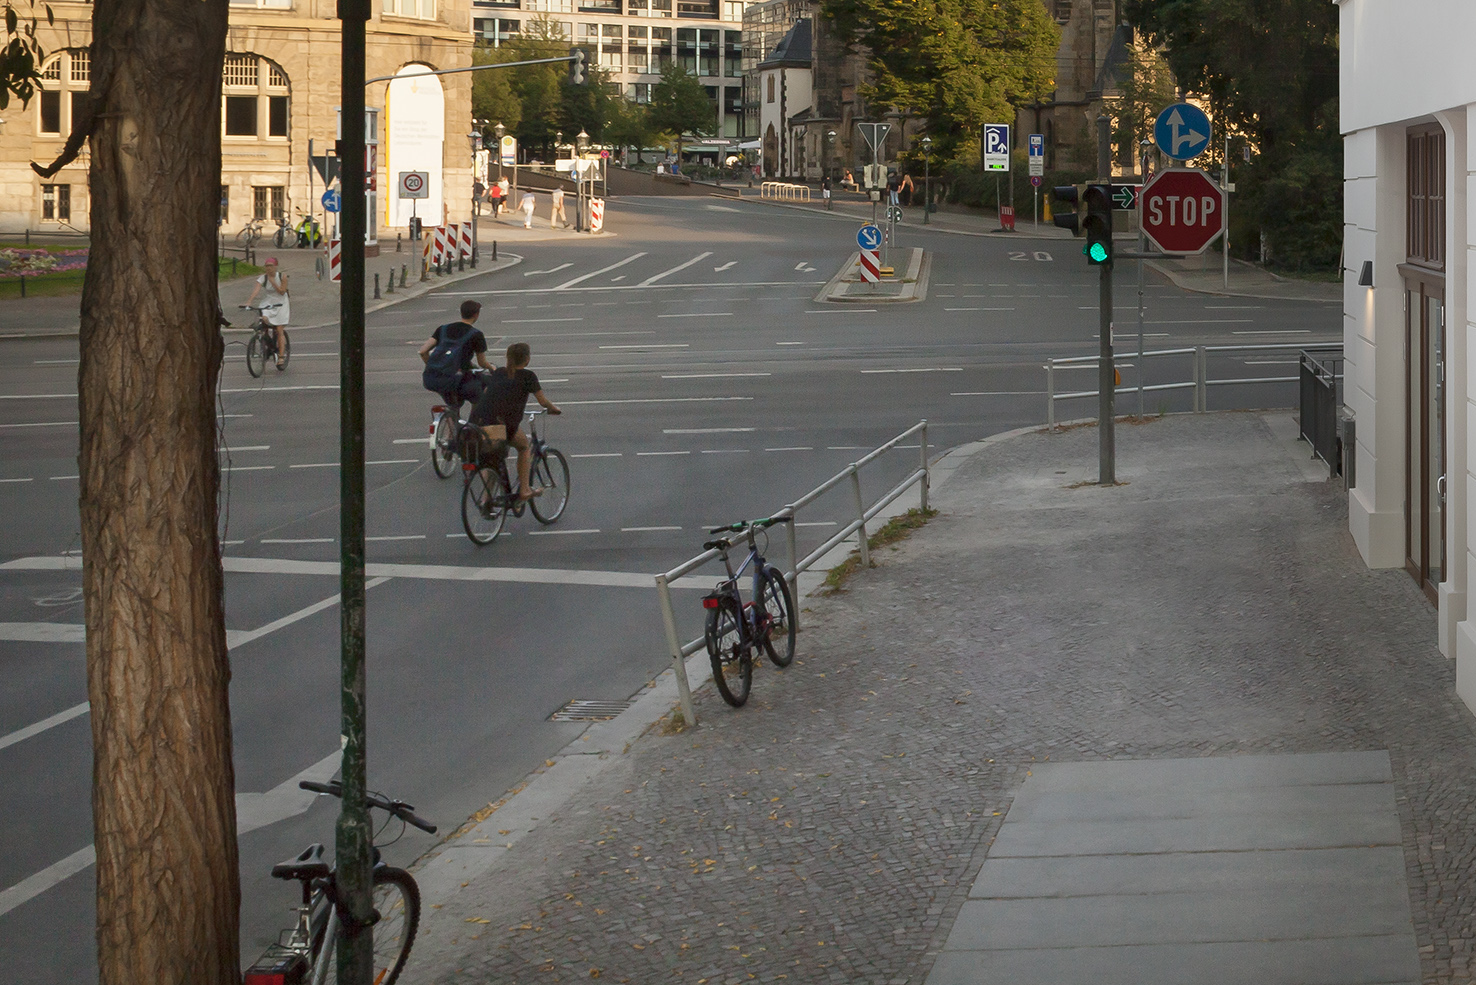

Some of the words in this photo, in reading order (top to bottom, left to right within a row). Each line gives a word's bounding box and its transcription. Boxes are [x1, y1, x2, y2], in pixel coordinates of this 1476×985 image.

[988, 133, 1000, 153] P
[408, 178, 420, 187] 20
[1149, 196, 1216, 227] STOP
[1008, 251, 1053, 261] 20
